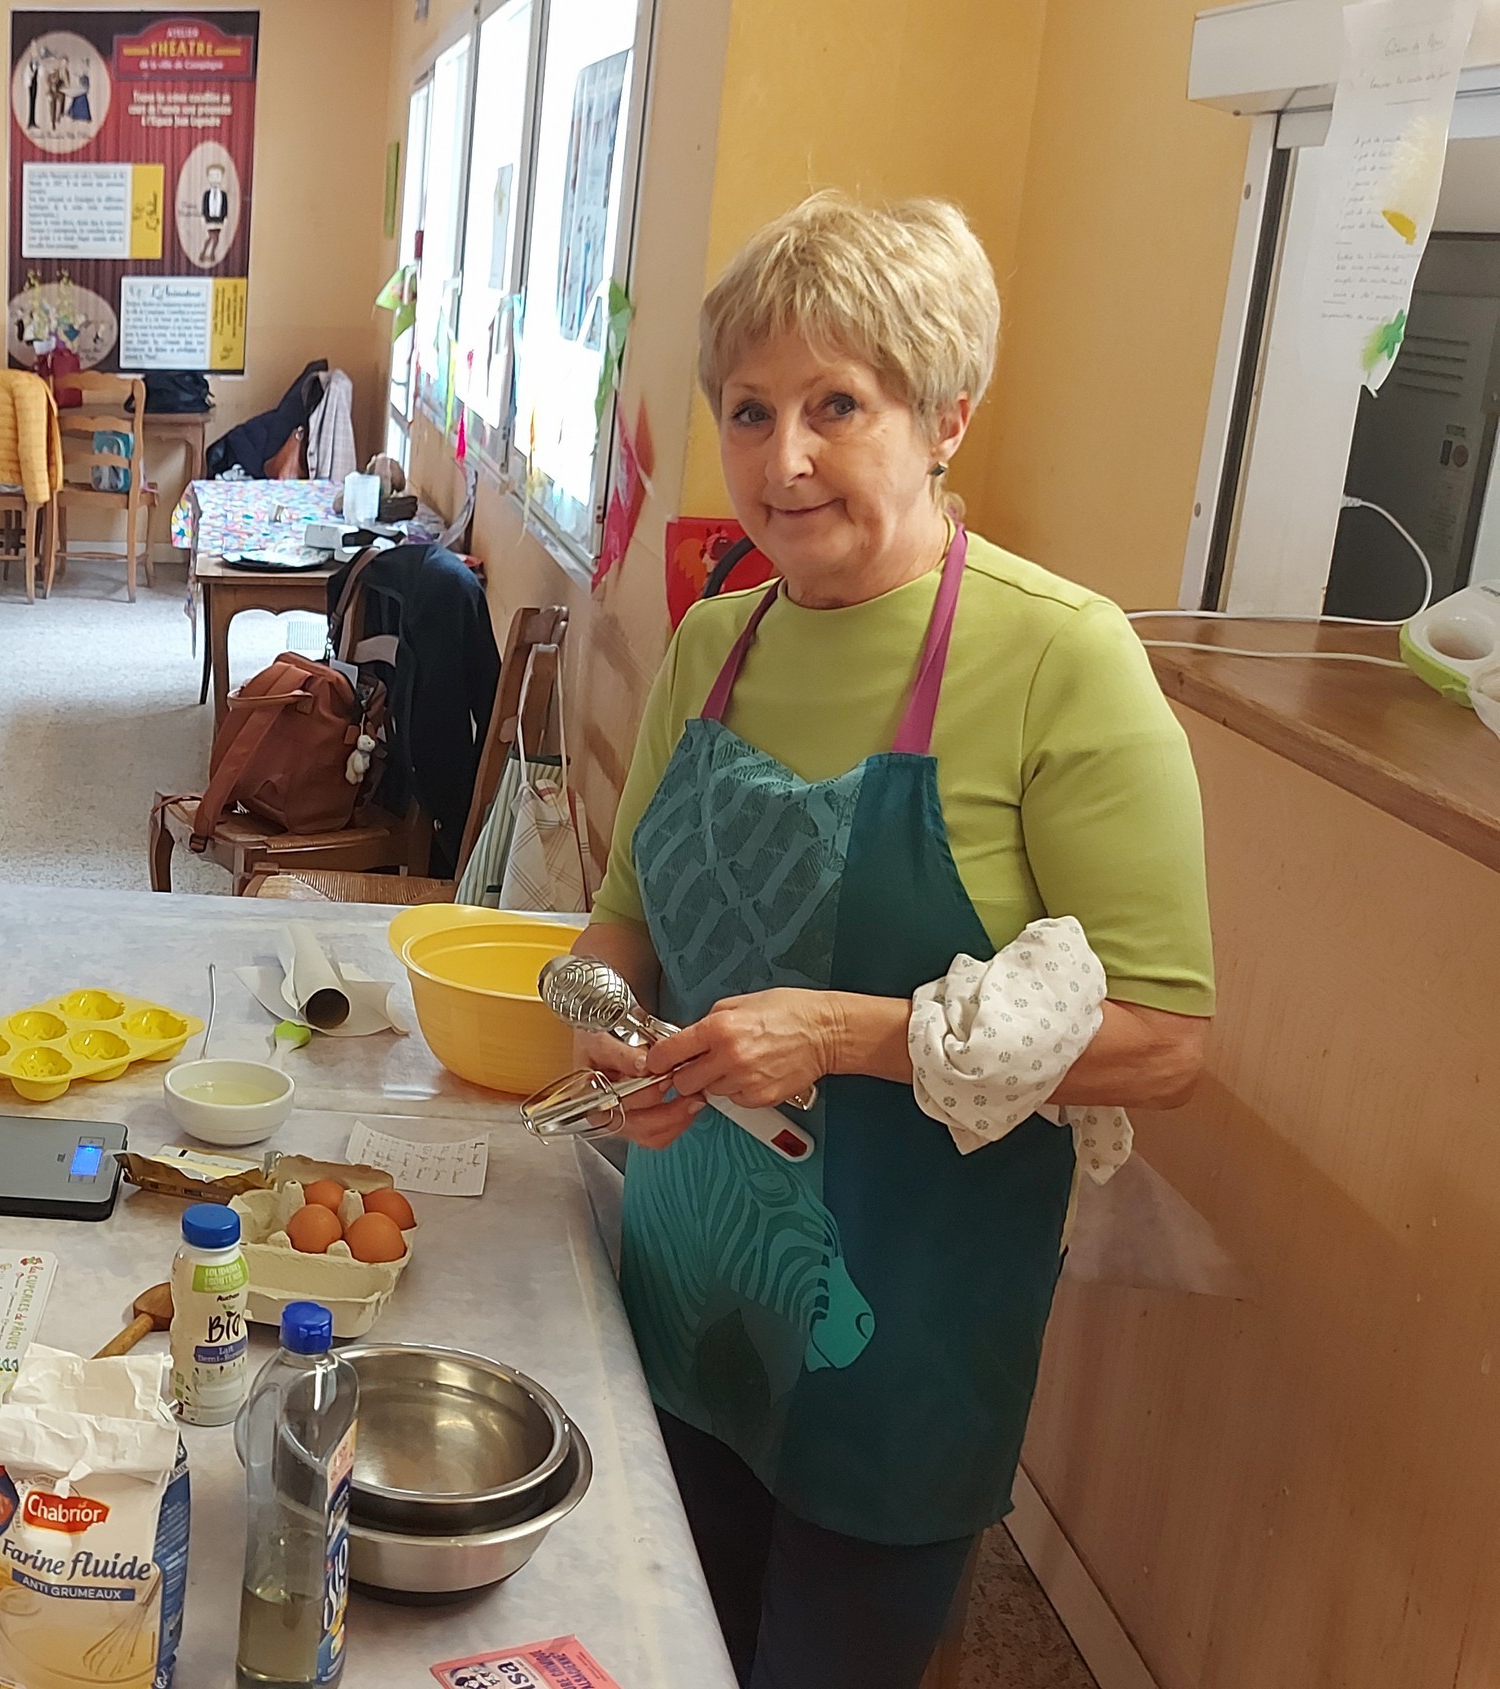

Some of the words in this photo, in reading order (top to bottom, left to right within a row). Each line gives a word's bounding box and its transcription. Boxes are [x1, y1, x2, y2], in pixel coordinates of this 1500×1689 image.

[17, 1274, 38, 1312] CUPCAKES
[5, 1321, 27, 1350] PÂQUES
[27, 1495, 103, 1523] Chabrior
[2, 1538, 66, 1575] Farine
[67, 1550, 151, 1581] fluide
[22, 1576, 49, 1594] ANTI
[50, 1586, 122, 1600] GRUMEAUX
